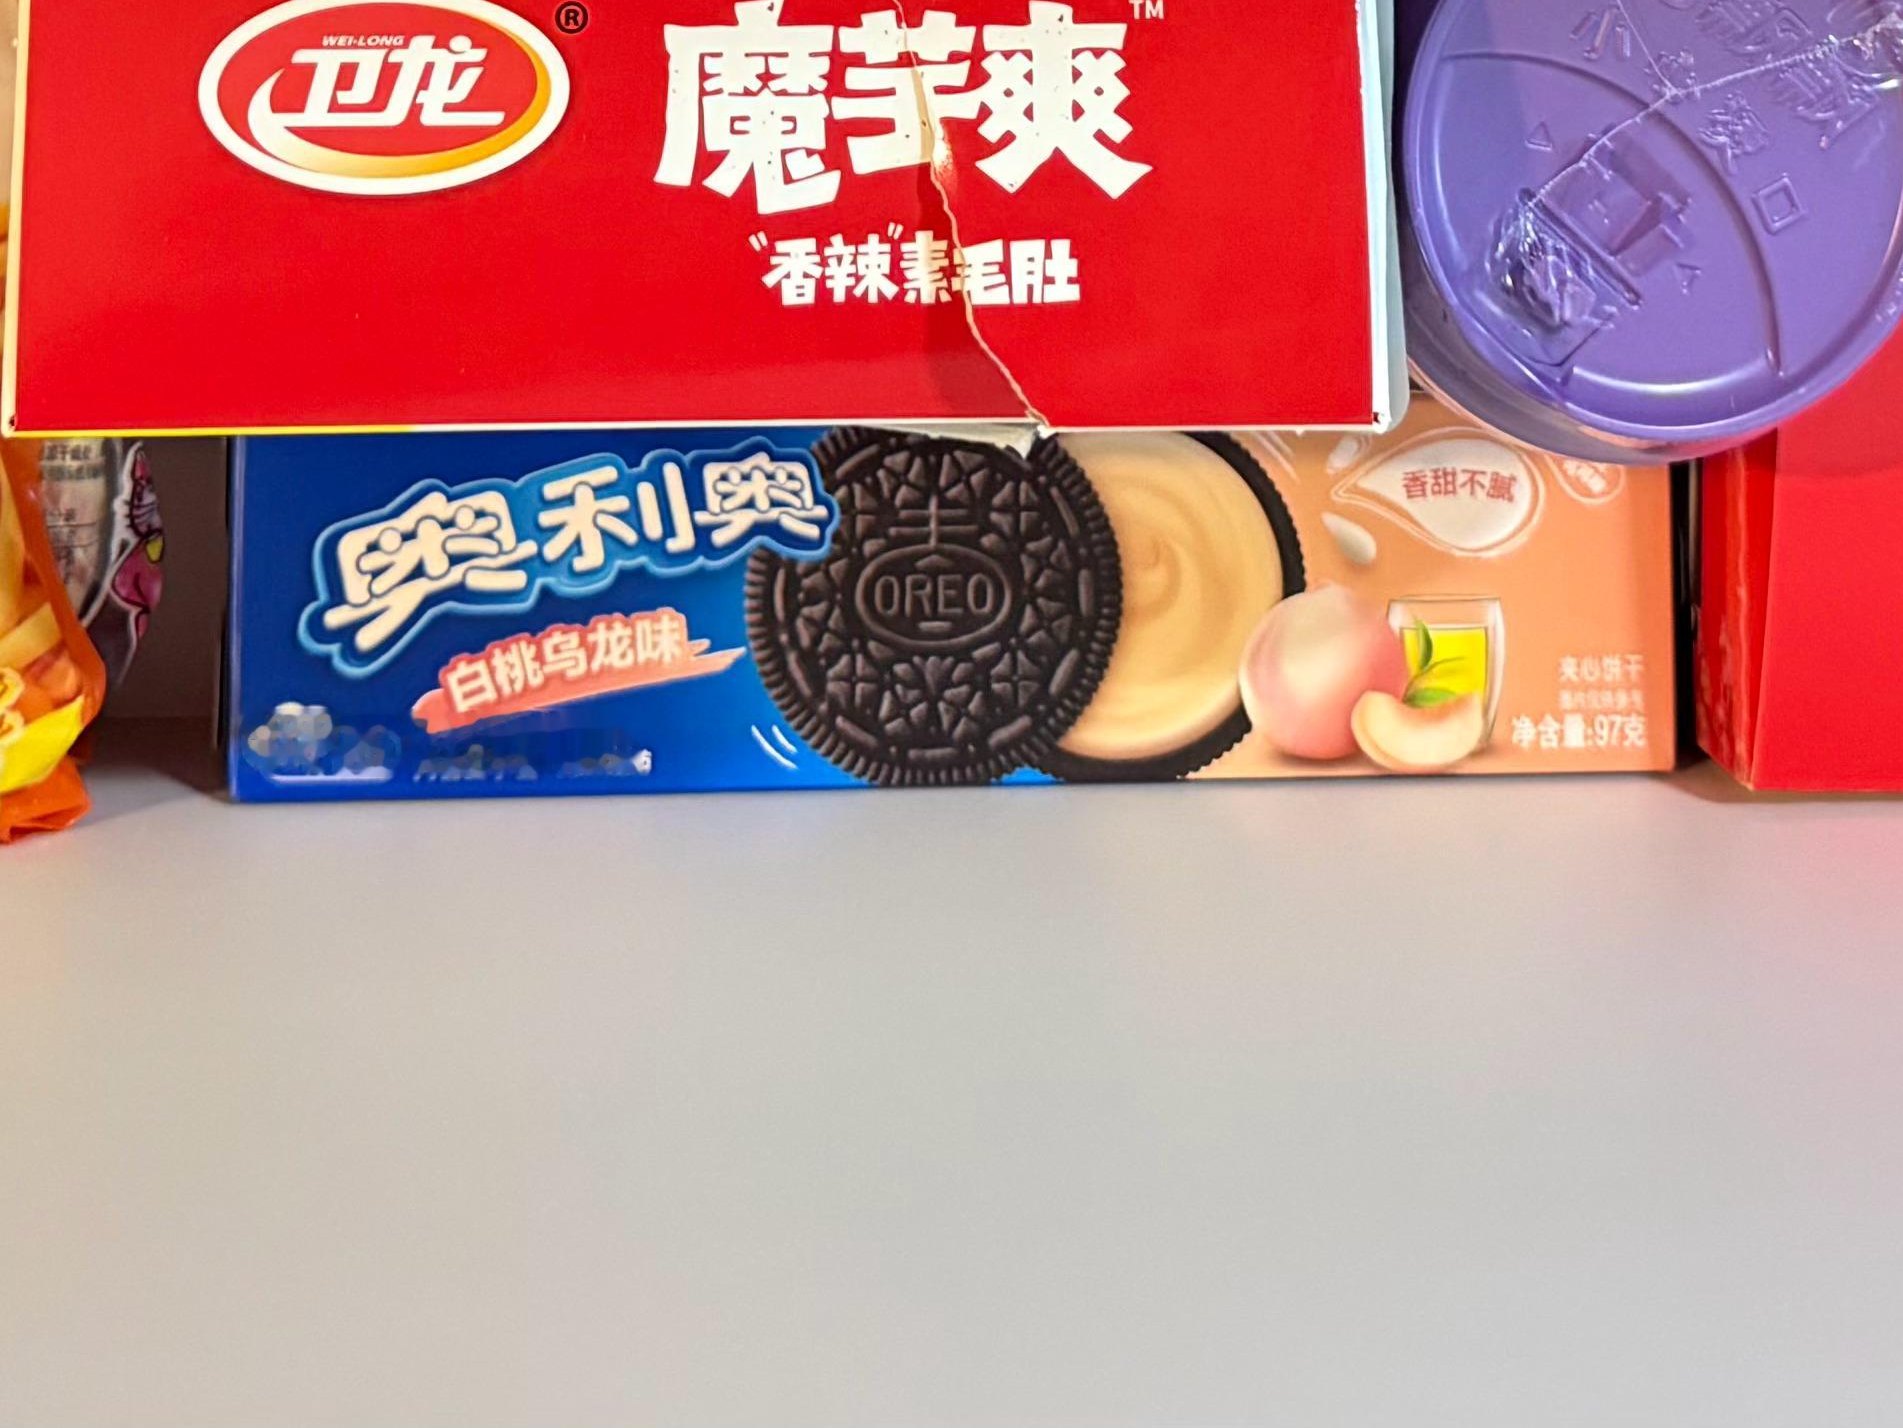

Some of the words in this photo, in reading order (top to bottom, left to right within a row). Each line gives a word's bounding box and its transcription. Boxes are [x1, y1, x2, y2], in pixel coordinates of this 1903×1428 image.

[286, 33, 506, 128] 卫龙
[1401, 467, 1517, 505] 香甜不腻
[324, 451, 828, 653] 奥利奥
[872, 571, 995, 618] OREO
[447, 608, 688, 715] 白桃乌龙味
